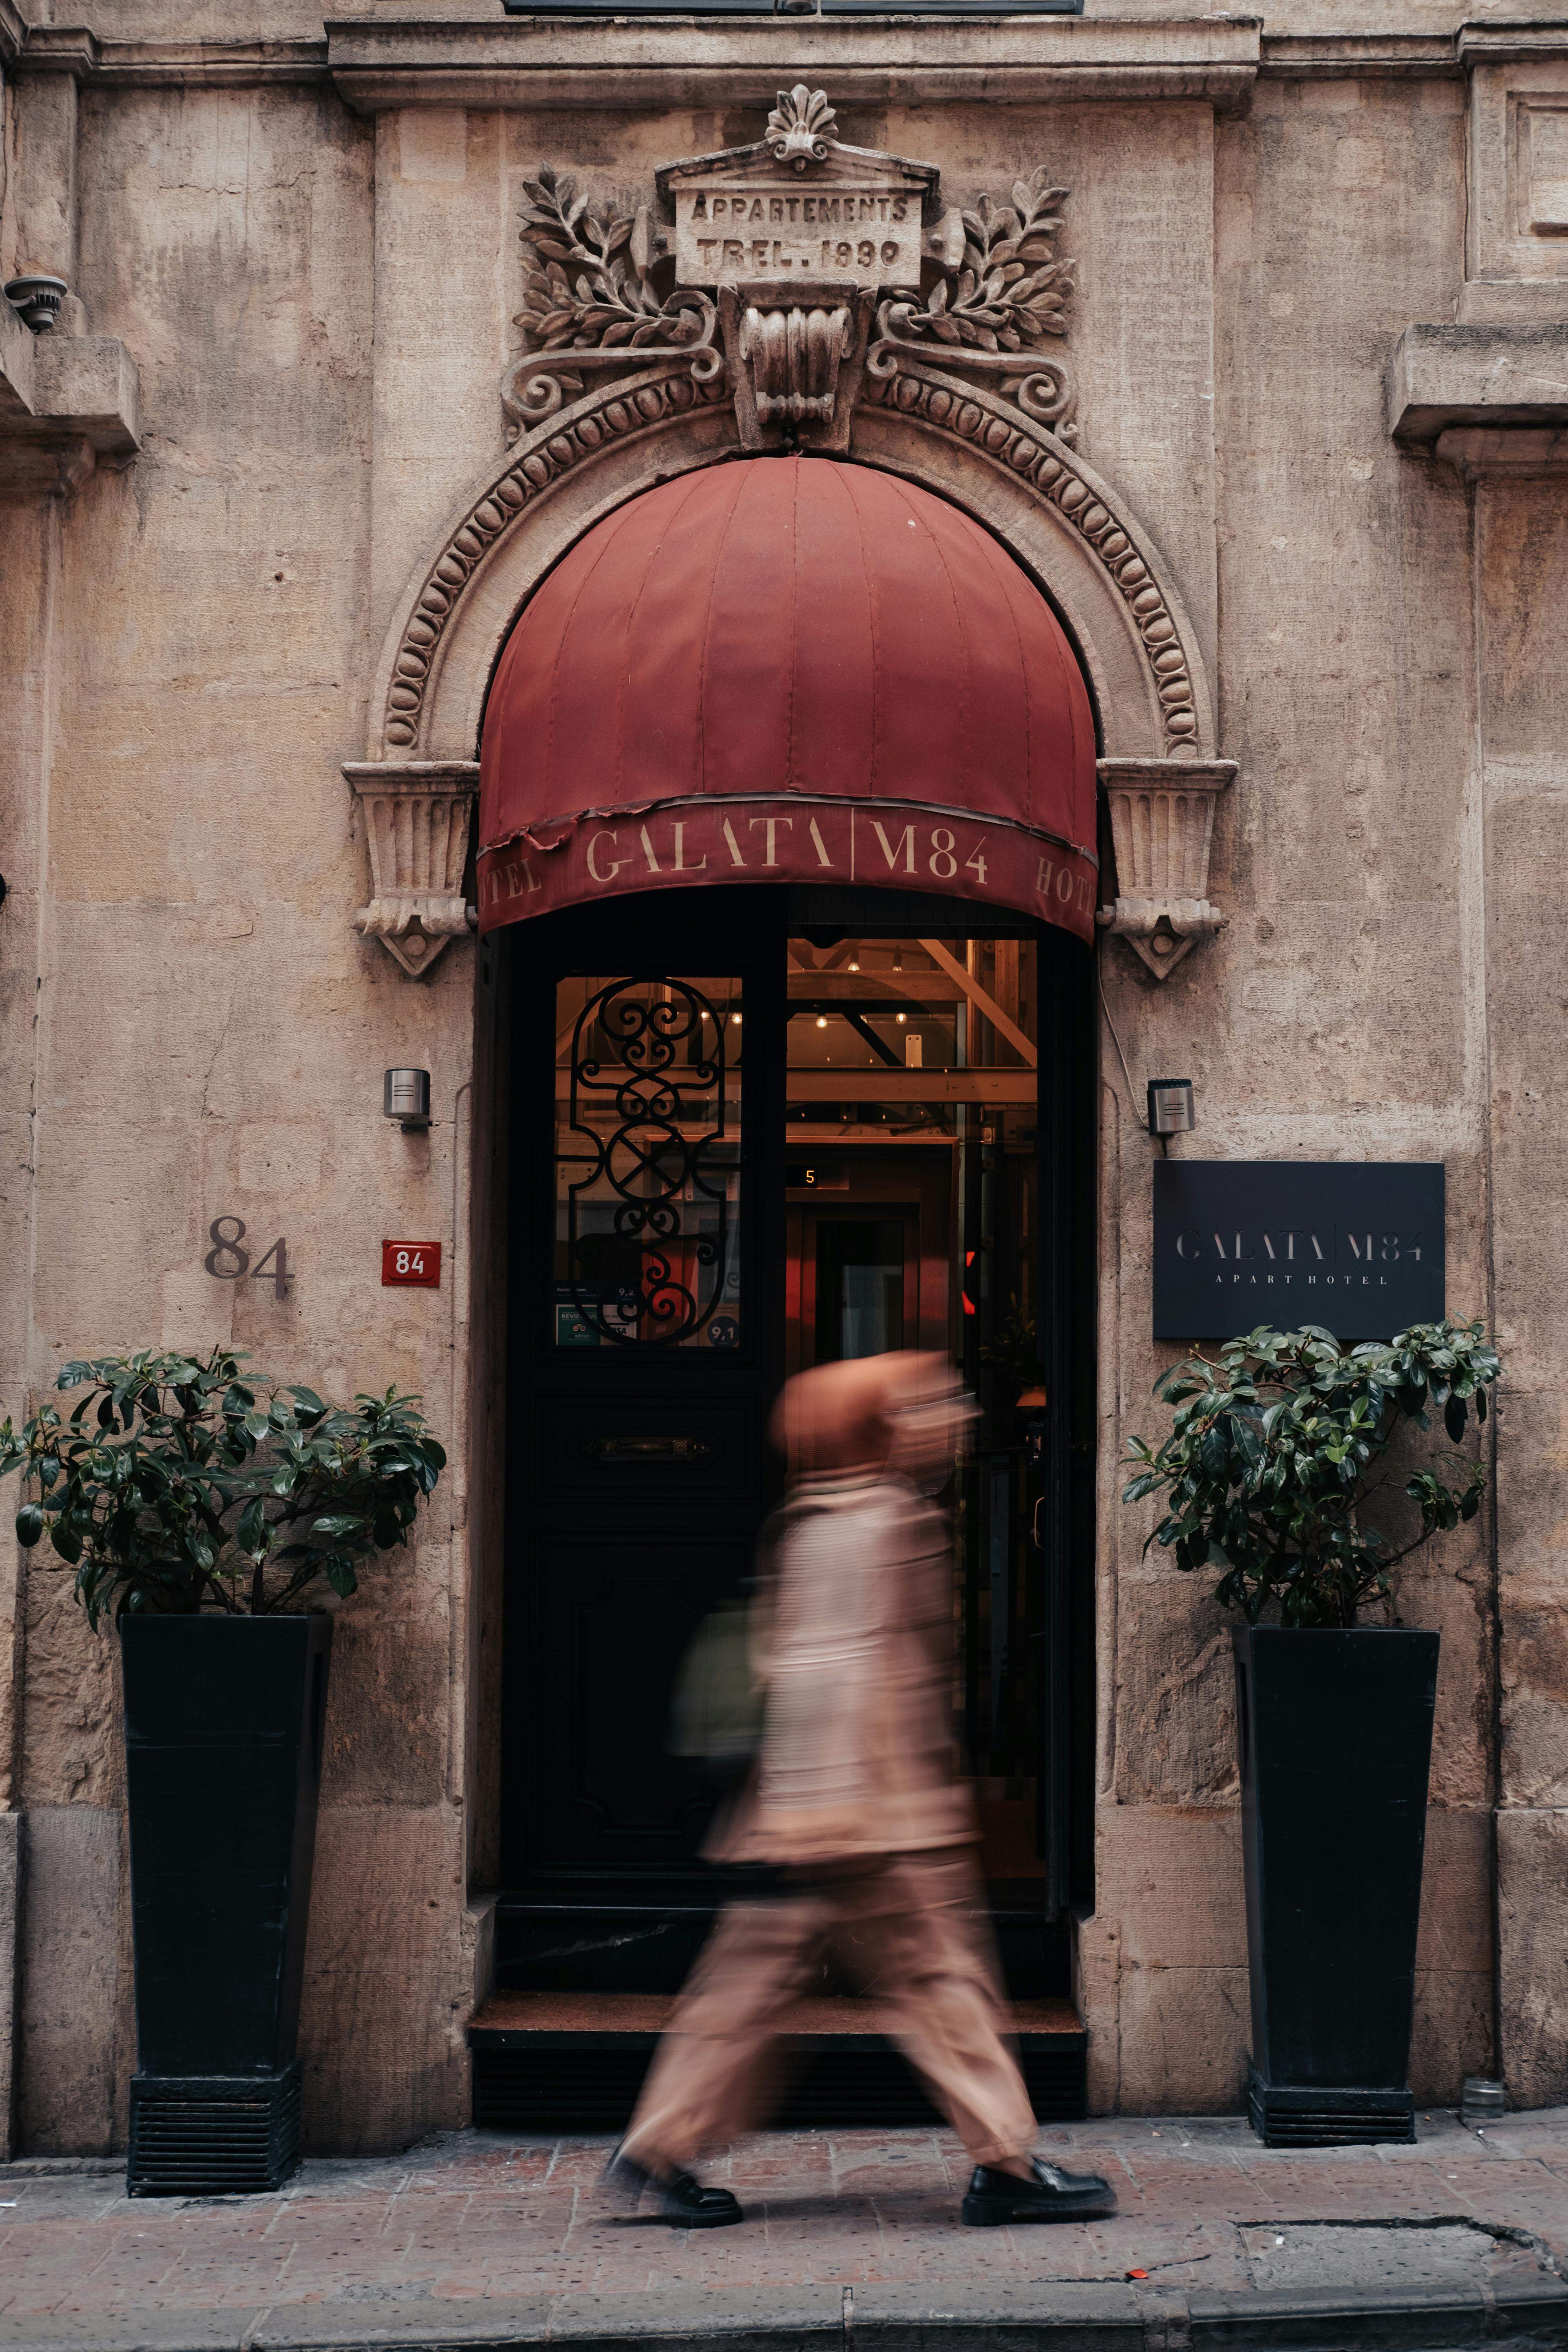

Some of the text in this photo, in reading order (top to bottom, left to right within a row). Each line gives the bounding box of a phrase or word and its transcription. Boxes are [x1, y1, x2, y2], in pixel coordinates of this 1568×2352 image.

[691, 191, 908, 223] APPARTEMENTS
[479, 817, 1095, 919] OTEL GALATA M84 HOTE
[806, 1170, 814, 1183] 5
[1177, 1230, 1423, 1261] GALATA M84
[205, 1216, 295, 1299] 84
[396, 1252, 423, 1274] 84
[1215, 1275, 1387, 1285] APART HOTEL
[618, 1288, 634, 1297] 9,2
[712, 1326, 734, 1341] 9,1
